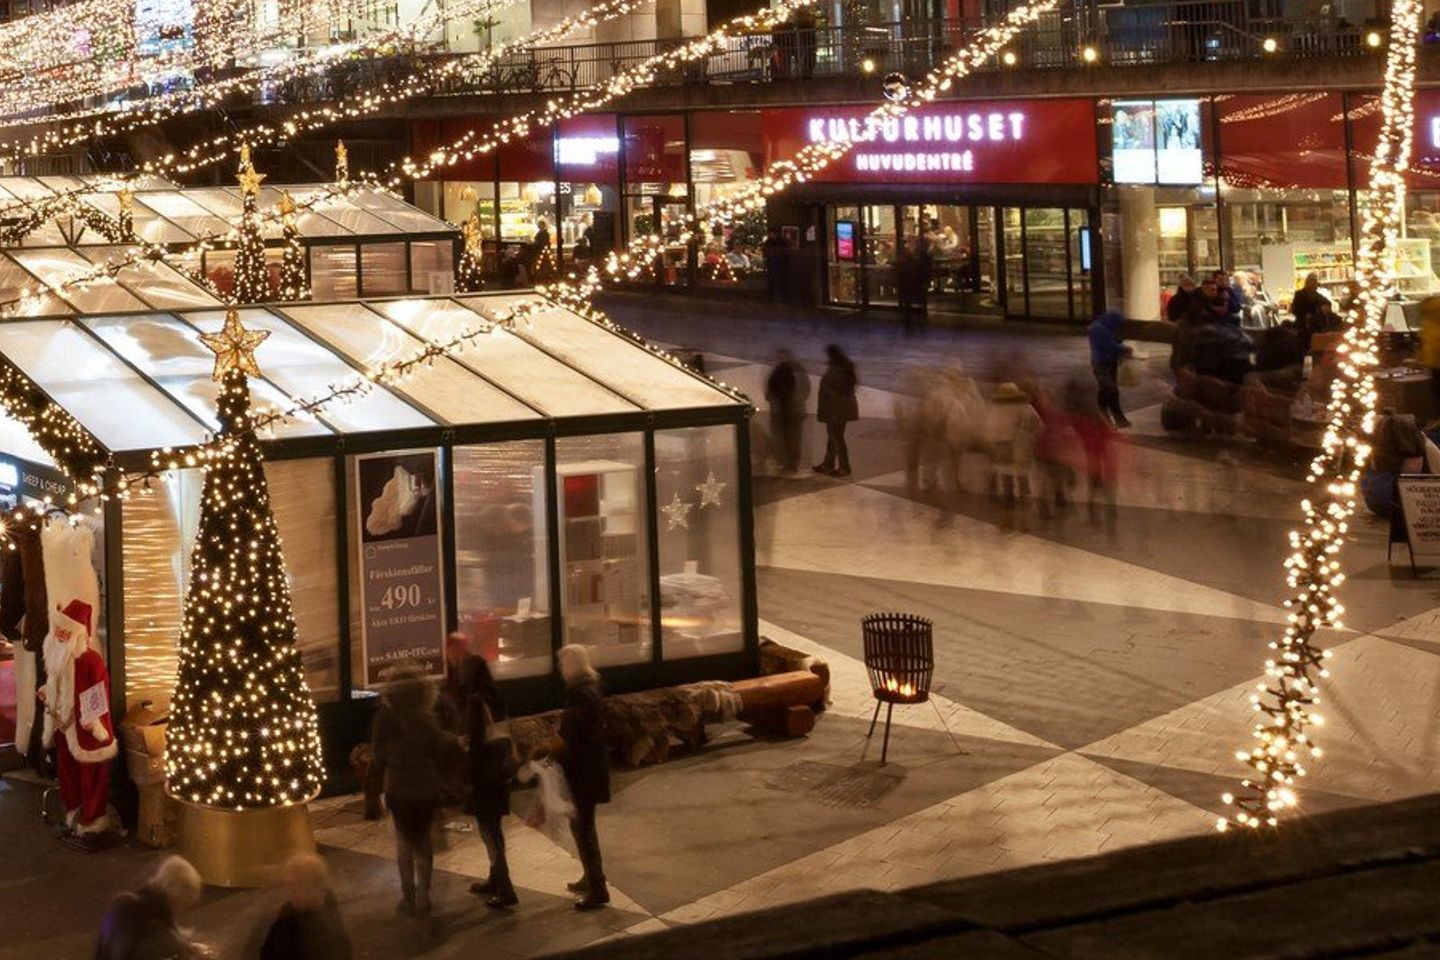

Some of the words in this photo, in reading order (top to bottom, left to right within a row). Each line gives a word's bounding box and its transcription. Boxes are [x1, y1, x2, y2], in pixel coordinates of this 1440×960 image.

[809, 113, 1025, 142] KULTURHUSET
[856, 150, 974, 171] HUVUDENTRÉ
[381, 583, 421, 610] 490
